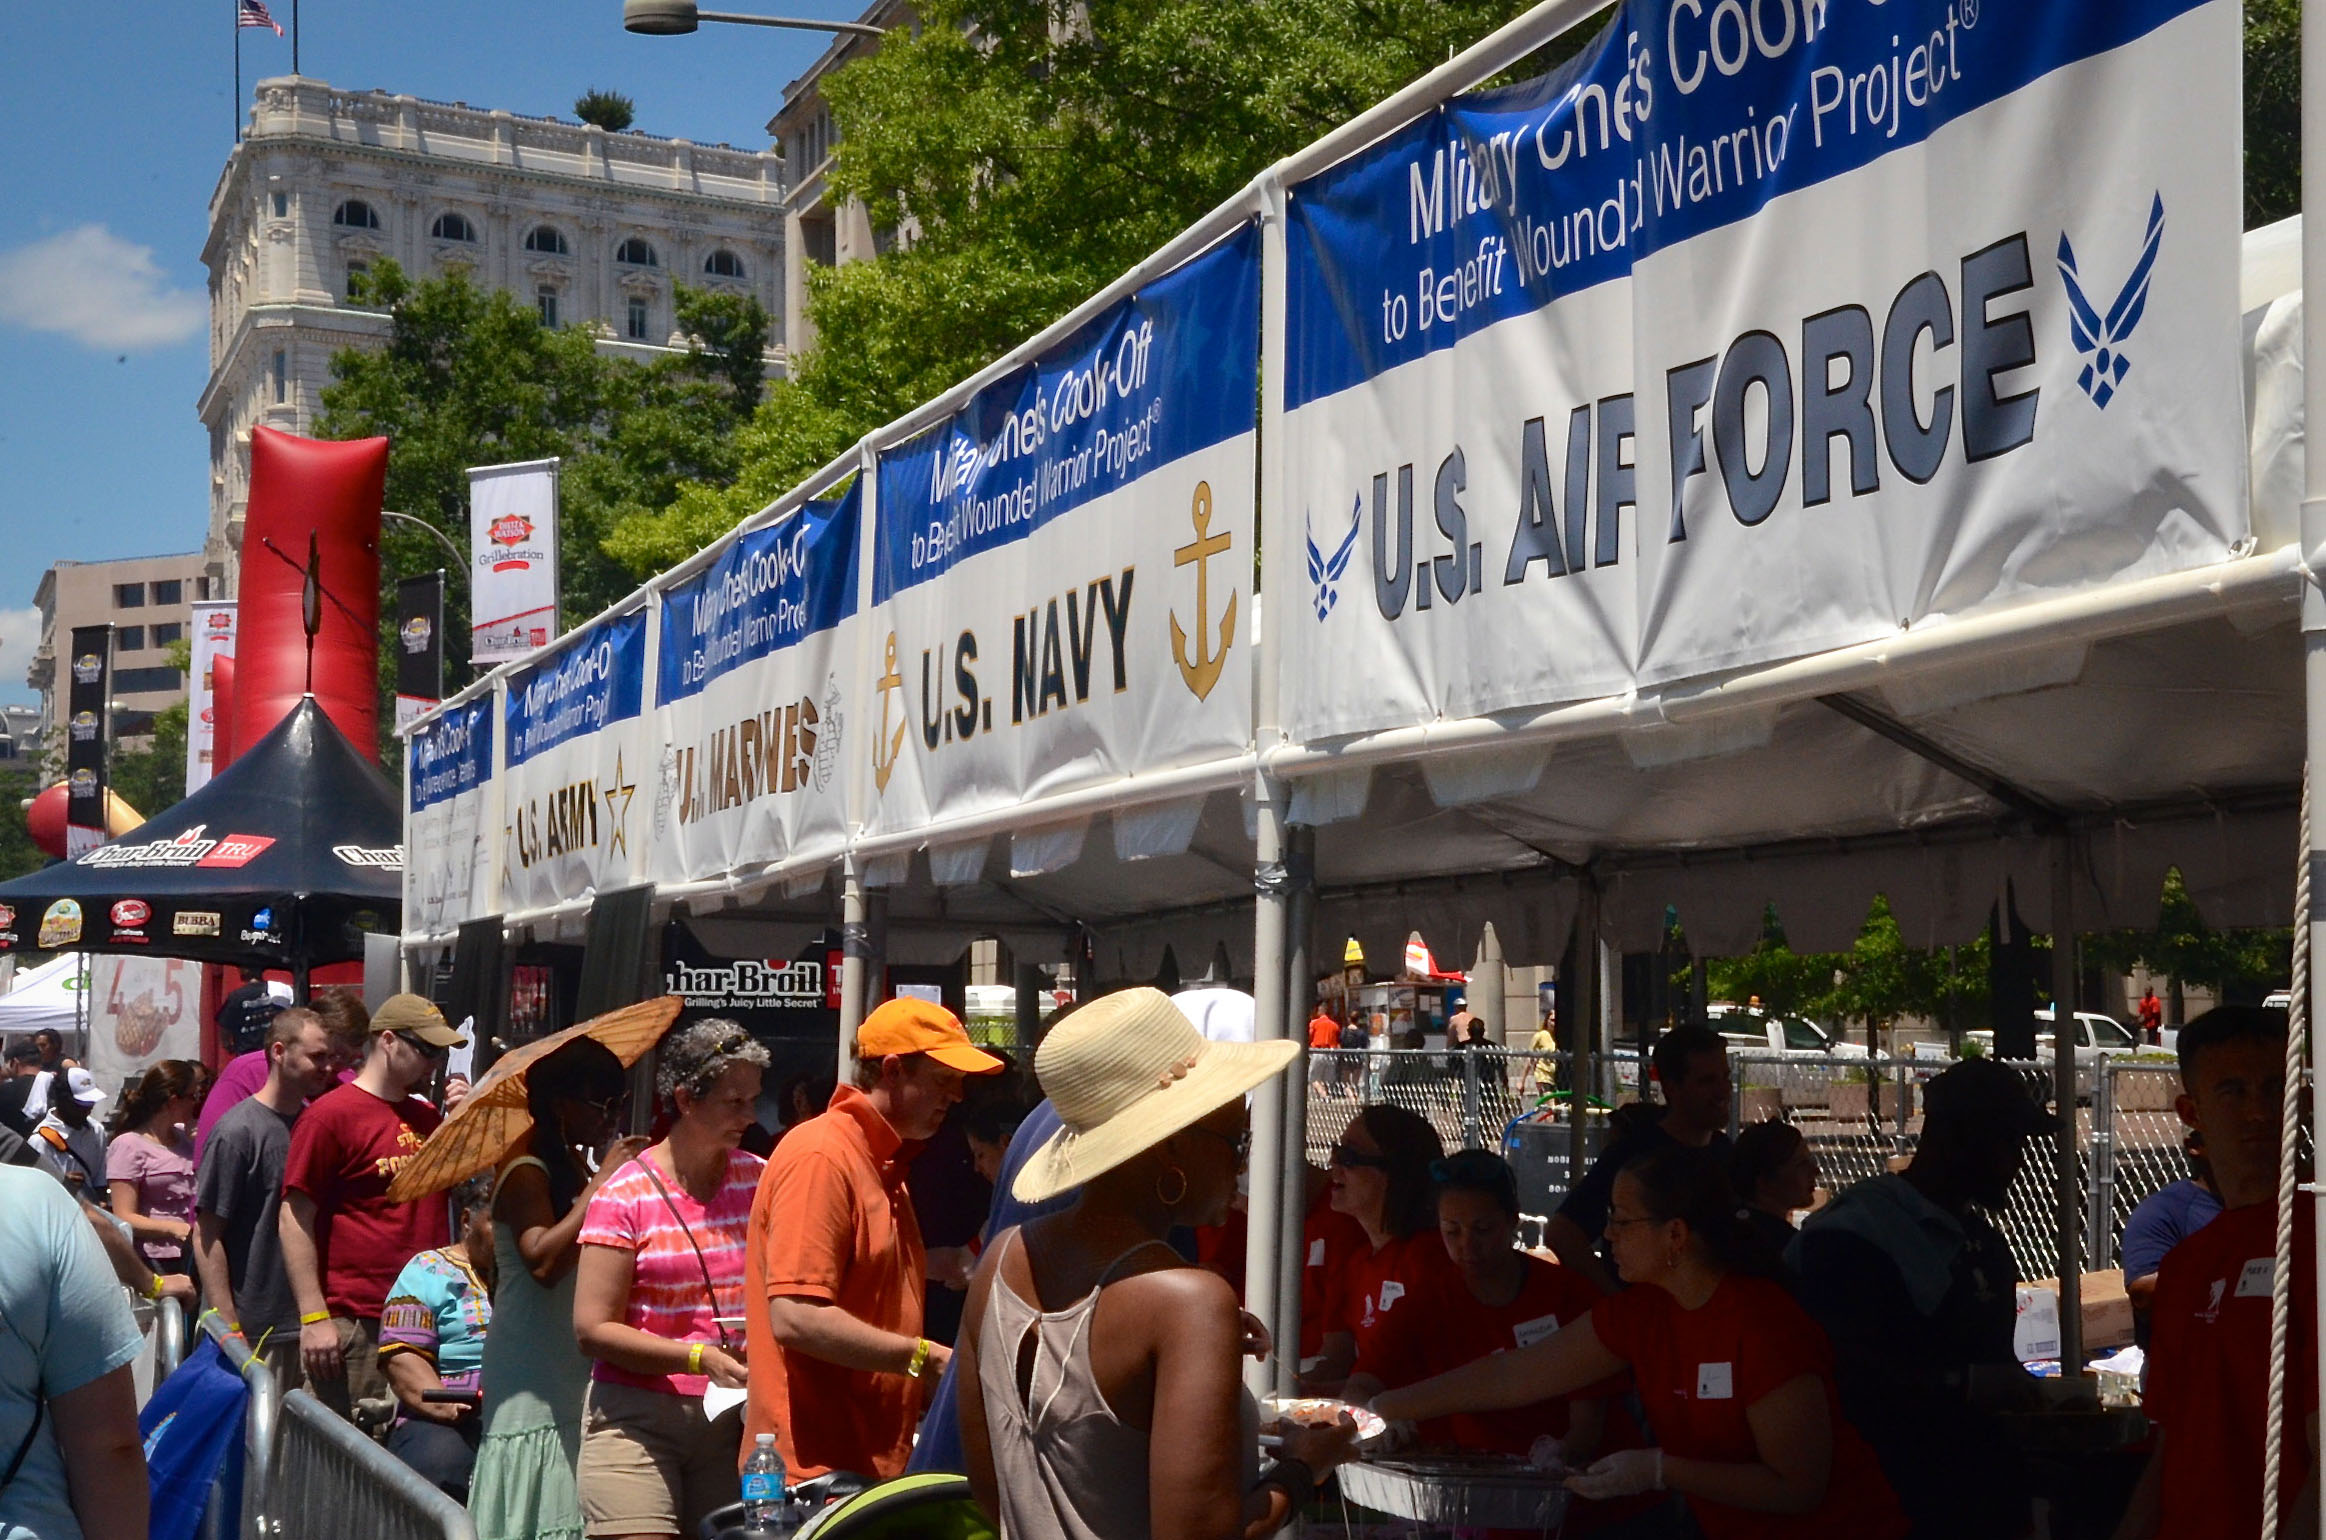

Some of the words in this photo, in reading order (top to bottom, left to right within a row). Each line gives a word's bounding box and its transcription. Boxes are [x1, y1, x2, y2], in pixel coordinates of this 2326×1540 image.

[1382, 287, 1408, 344] to
[1419, 235, 1507, 331] Benefit
[1051, 319, 1154, 434] Cook-Off
[1372, 442, 1483, 622] U.S.
[1666, 230, 2041, 546] FORCE
[912, 531, 926, 570] to
[961, 466, 1039, 541] Wounded
[1040, 445, 1092, 508] Warrior
[921, 627, 992, 753] U.S.
[1011, 563, 1136, 728] NAVY
[666, 959, 822, 997] har-Broil
[684, 996, 728, 1010] Grilling's
[729, 996, 754, 1010] Juicy
[756, 996, 782, 1008] Little
[783, 996, 818, 1009] Secret
